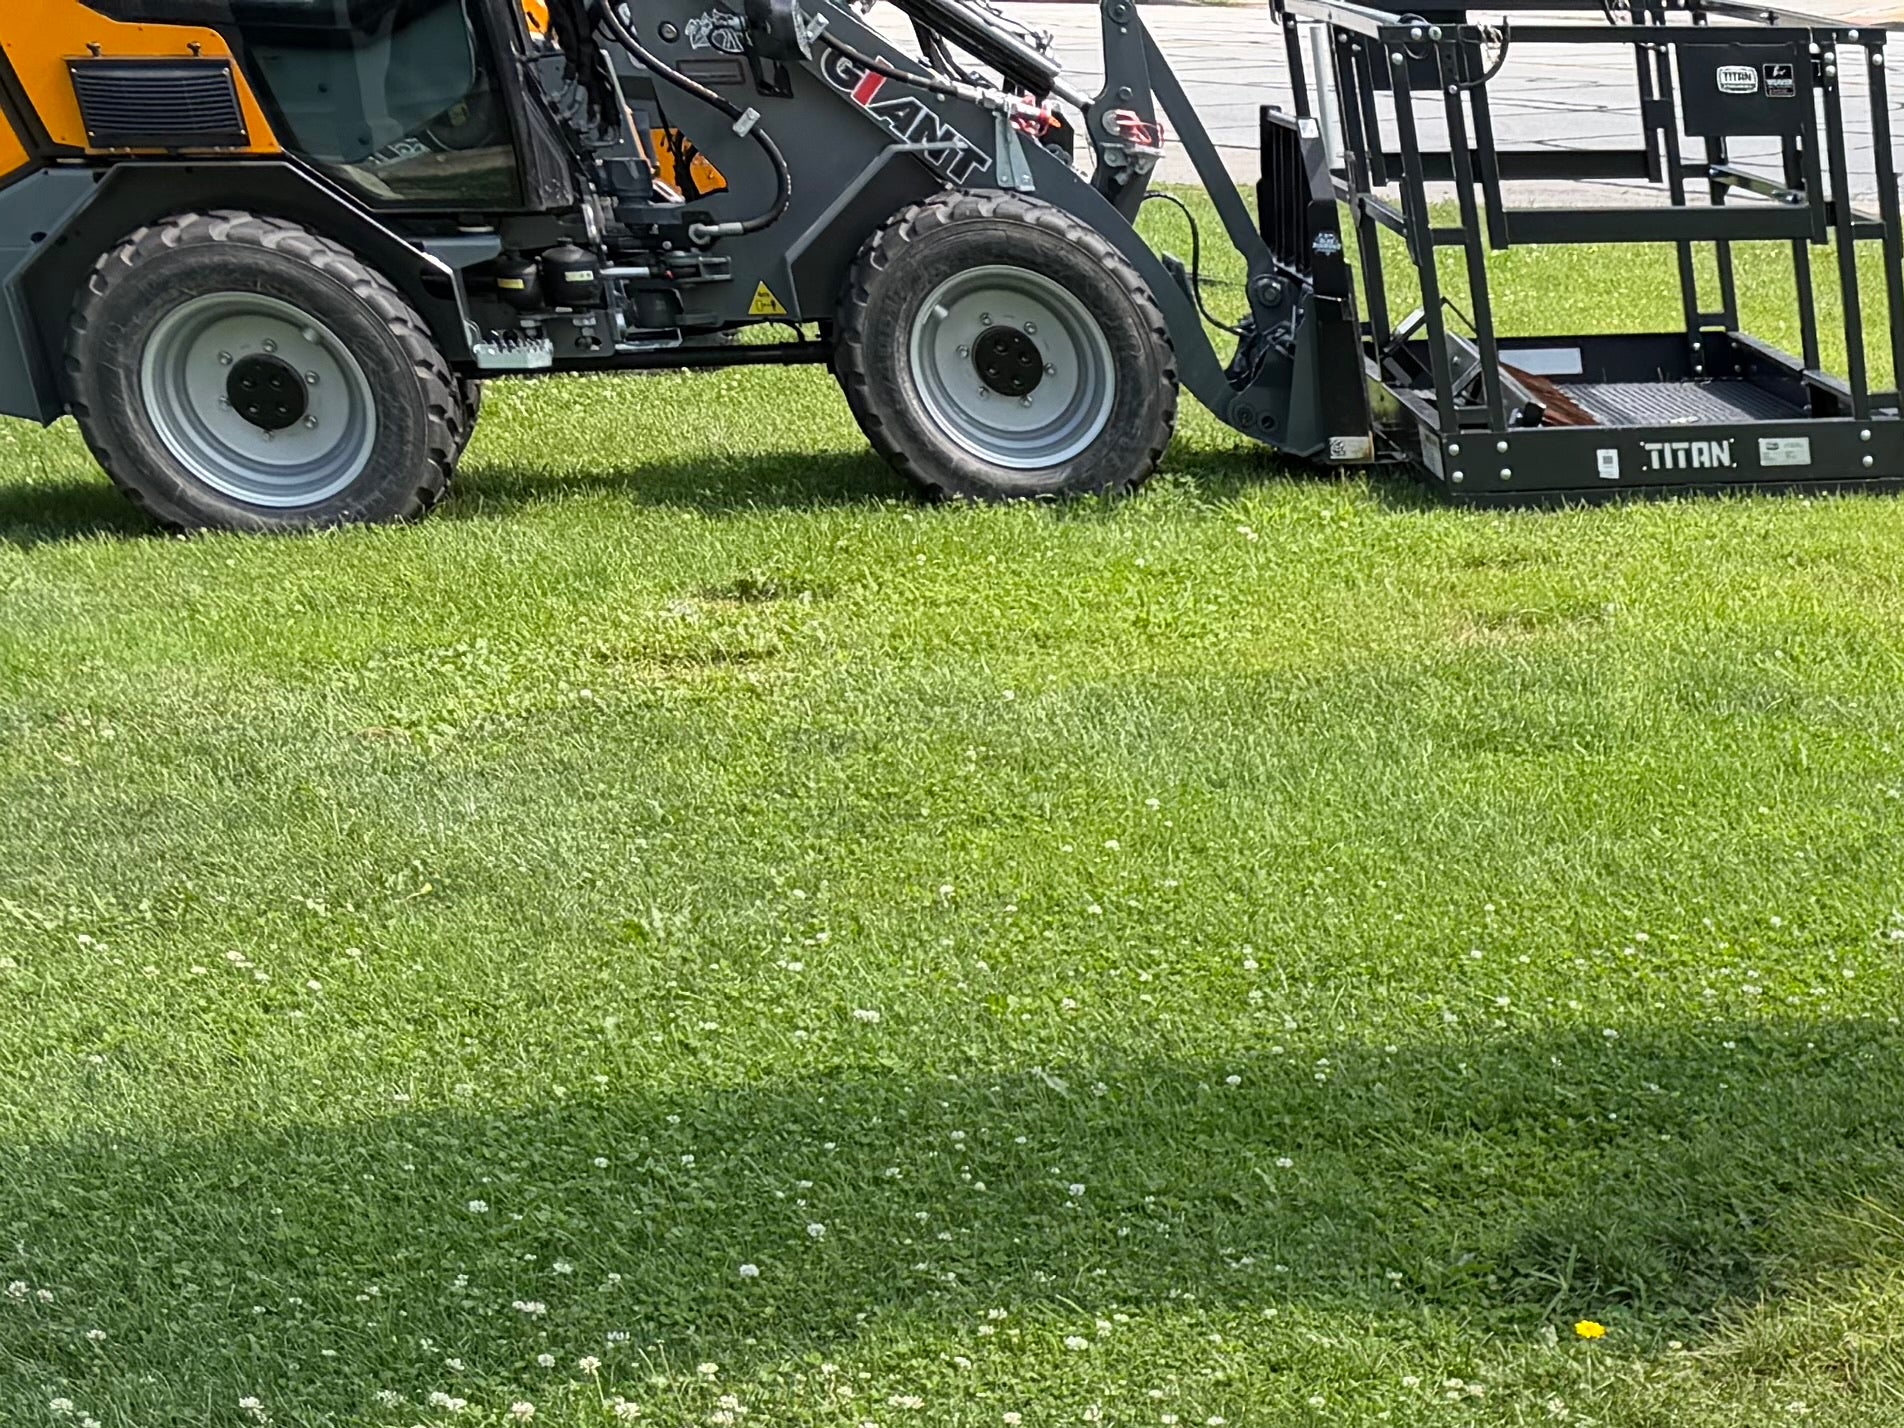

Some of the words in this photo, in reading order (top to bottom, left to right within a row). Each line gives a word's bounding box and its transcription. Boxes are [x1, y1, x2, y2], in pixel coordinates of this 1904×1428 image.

[1721, 71, 1752, 82] TITAN
[820, 46, 992, 185] GIANT
[1644, 440, 1731, 469] TITAN
